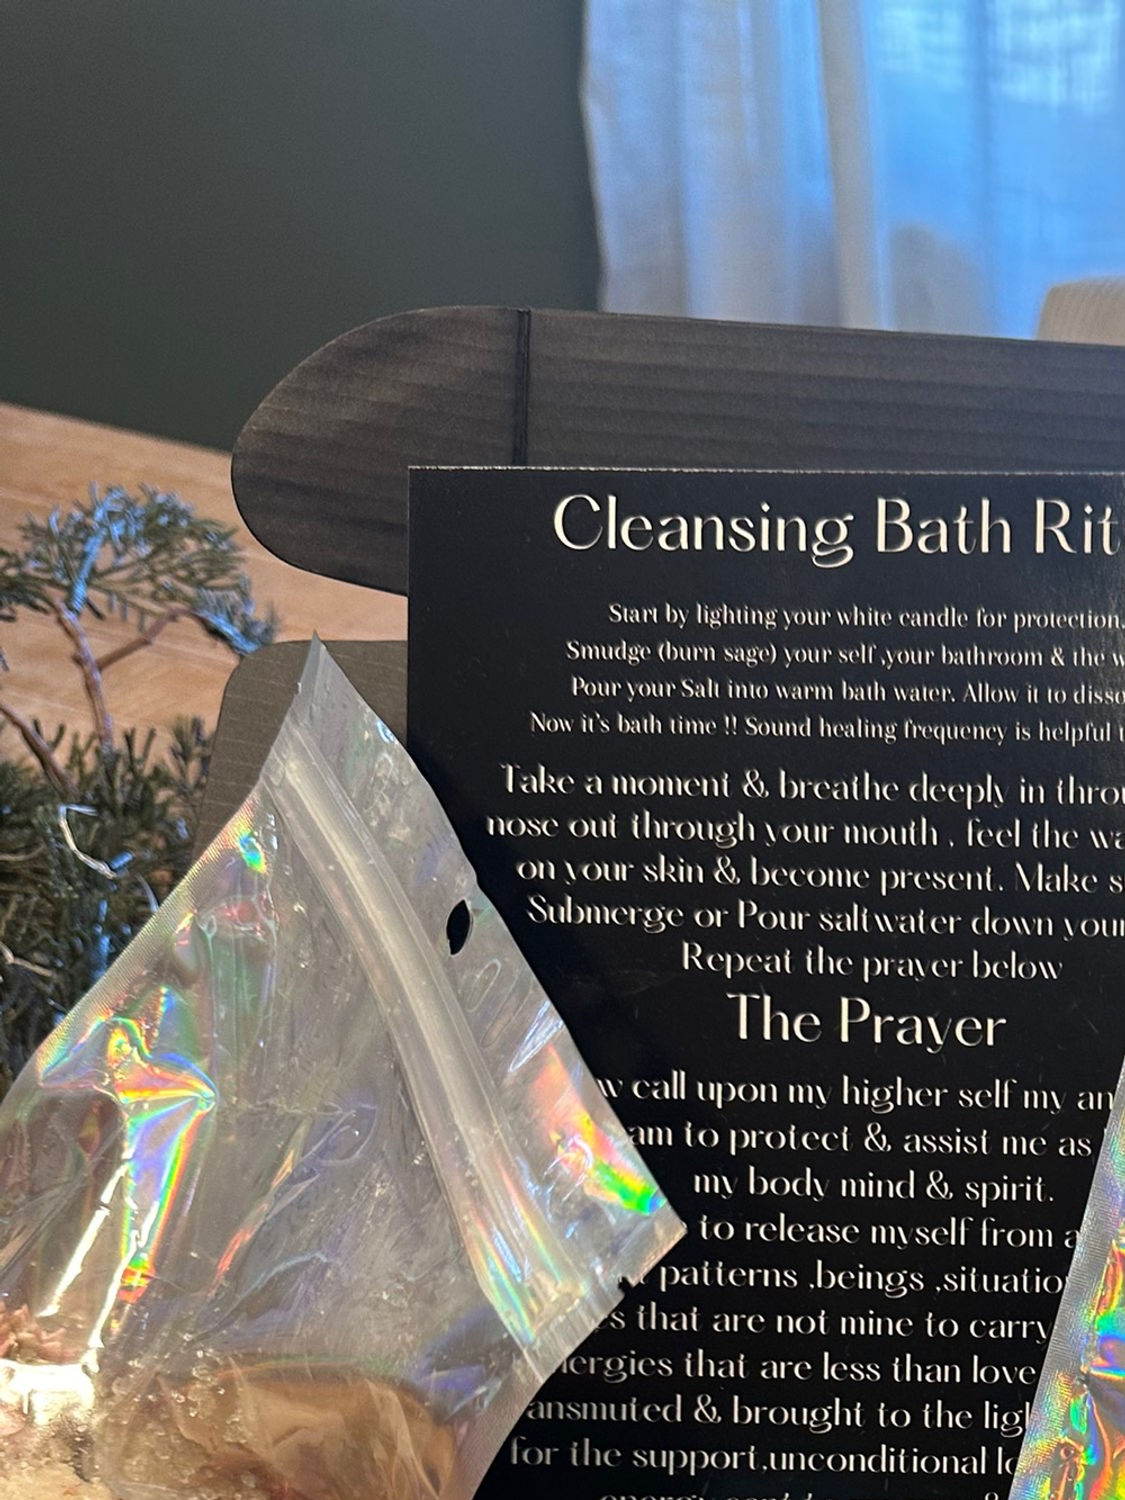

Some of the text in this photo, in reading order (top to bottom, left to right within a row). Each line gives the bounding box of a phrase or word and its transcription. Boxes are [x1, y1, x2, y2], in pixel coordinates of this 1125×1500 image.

[554, 494, 855, 568] Cleansing
[876, 497, 1011, 555] Bath
[609, 603, 1125, 633] Start by lighting your white candle for protection.
[567, 640, 651, 666] Smudge
[658, 641, 716, 664] (burn
[724, 643, 777, 668] sage)
[783, 648, 832, 668] your
[838, 644, 876, 666] self
[942, 645, 1042, 667] bathroom
[1073, 647, 1105, 667] the
[572, 677, 621, 697] Pour
[627, 680, 676, 702] your
[681, 677, 720, 698] Salt
[727, 679, 768, 700] into
[775, 684, 834, 701] warm
[842, 681, 886, 702] bath
[893, 685, 956, 703] water.
[963, 683, 1019, 704] Allow
[1027, 685, 1039, 705] it
[1047, 686, 1067, 705] to
[530, 712, 573, 733] Now
[581, 713, 610, 733] it's
[618, 714, 662, 735] bath
[670, 716, 716, 736] time
[723, 715, 737, 736] !!
[745, 716, 810, 738] Sound
[819, 717, 897, 744] healing
[904, 719, 1004, 746] frequency
[1015, 722, 1031, 742] is
[1038, 721, 1111, 747] helpful
[501, 763, 574, 794] Take
[584, 776, 602, 795] a
[611, 771, 729, 797] moment
[780, 768, 900, 801] breathe
[909, 771, 1003, 810] deeply
[1019, 777, 1045, 804] in
[487, 814, 559, 836] nose
[569, 814, 616, 838] out
[632, 810, 755, 848] through
[765, 821, 834, 846] your
[843, 816, 937, 846] mouth
[967, 817, 1021, 847] feel
[1032, 820, 1079, 849] the
[516, 860, 555, 880] on
[564, 860, 634, 884] your
[644, 853, 703, 883] skin
[751, 856, 869, 888] become
[881, 865, 1003, 896] present.
[1016, 862, 1097, 893] Make
[528, 895, 683, 933] Submerge
[694, 908, 728, 929] or
[738, 900, 811, 930] Pour
[971, 906, 1053, 936] down
[683, 940, 1063, 982] Repeat the prayer below
[727, 993, 1007, 1054] The Prayer
[632, 1070, 686, 1100] call
[698, 1081, 778, 1108] upon
[789, 1083, 830, 1109] my
[843, 1075, 948, 1114] higher
[958, 1078, 1017, 1109] self
[1023, 1089, 1067, 1115] my
[685, 1121, 1092, 1157] to protect assist me as
[694, 1165, 1054, 1209] my body mind spirit.
[700, 1214, 735, 1240] to
[745, 1212, 859, 1243] release
[871, 1217, 973, 1250] myself
[981, 1217, 1053, 1248] from
[661, 1261, 798, 1292] patterns
[638, 1301, 700, 1331] that
[713, 1313, 765, 1332] are
[777, 1310, 829, 1336] not
[841, 1310, 913, 1337] mine
[925, 1312, 958, 1338] to
[970, 1319, 1052, 1345] carry
[686, 1349, 746, 1378] that
[761, 1361, 812, 1380] are
[823, 1352, 881, 1382] less
[892, 1353, 960, 1383] than
[973, 1354, 1036, 1385] love
[527, 1394, 682, 1423] ansmuted
[733, 1395, 864, 1433] brought
[878, 1402, 911, 1429] to
[922, 1400, 973, 1430] the
[510, 1436, 559, 1466] for
[570, 1438, 622, 1467] the
